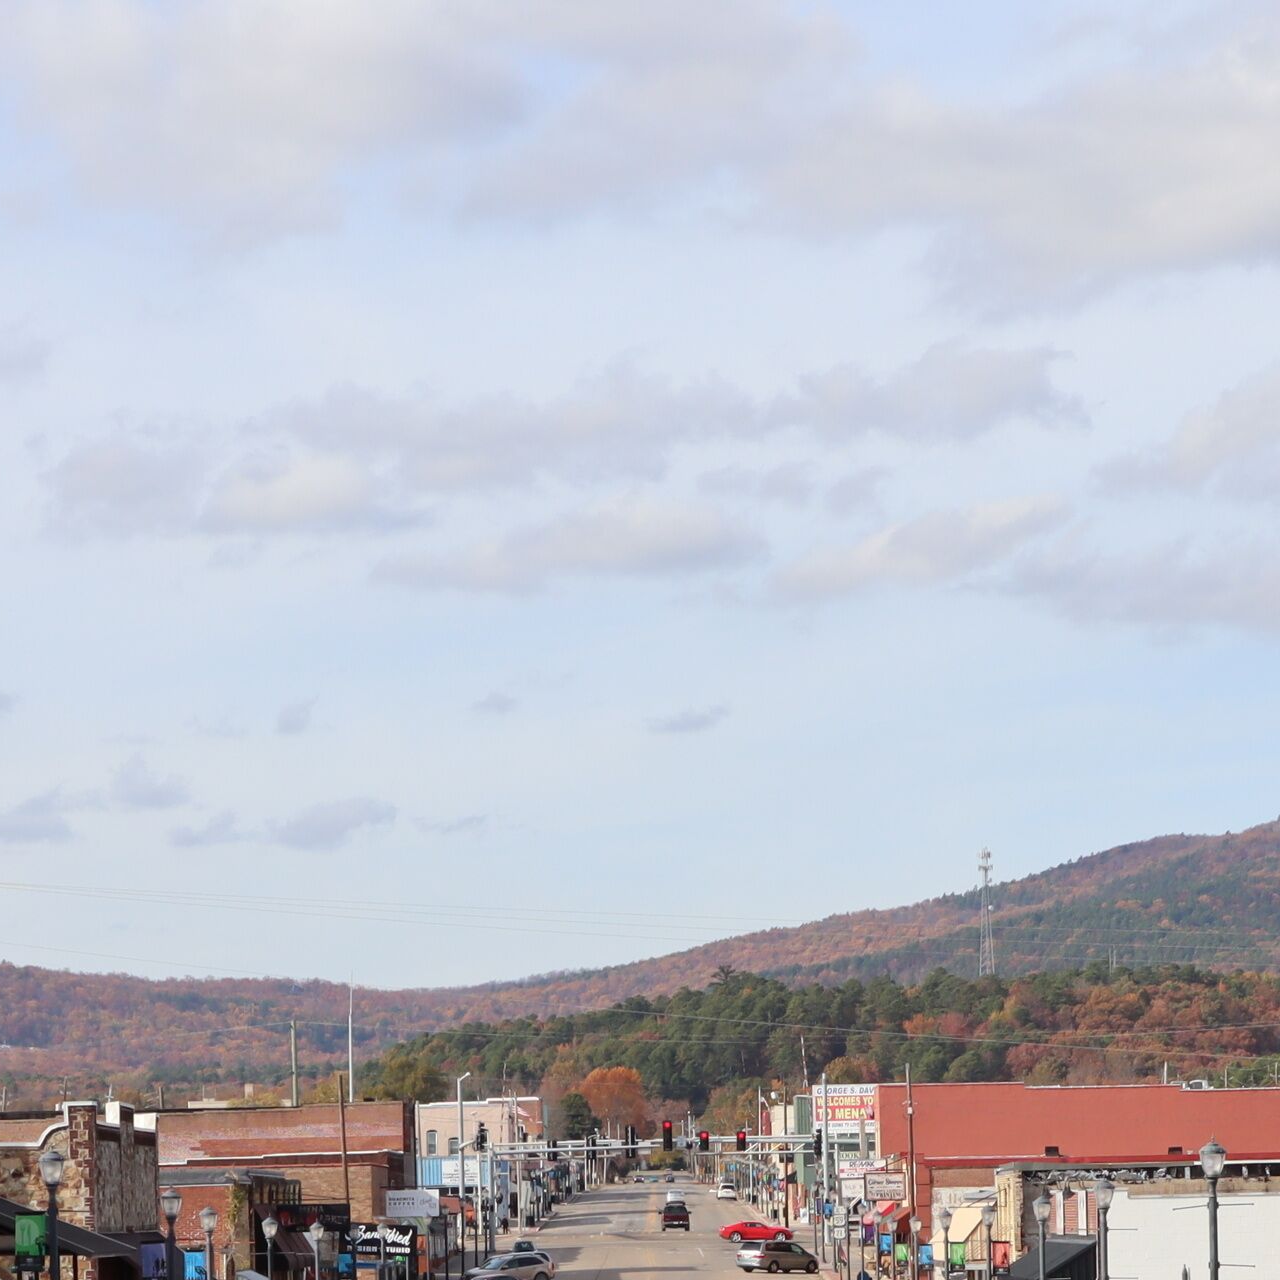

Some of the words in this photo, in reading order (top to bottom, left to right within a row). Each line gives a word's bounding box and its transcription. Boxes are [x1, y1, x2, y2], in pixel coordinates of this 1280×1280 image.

[816, 1087, 848, 1095] GORGE
[835, 1108, 867, 1120] MENA
[384, 1246, 411, 1254] TUDIO
